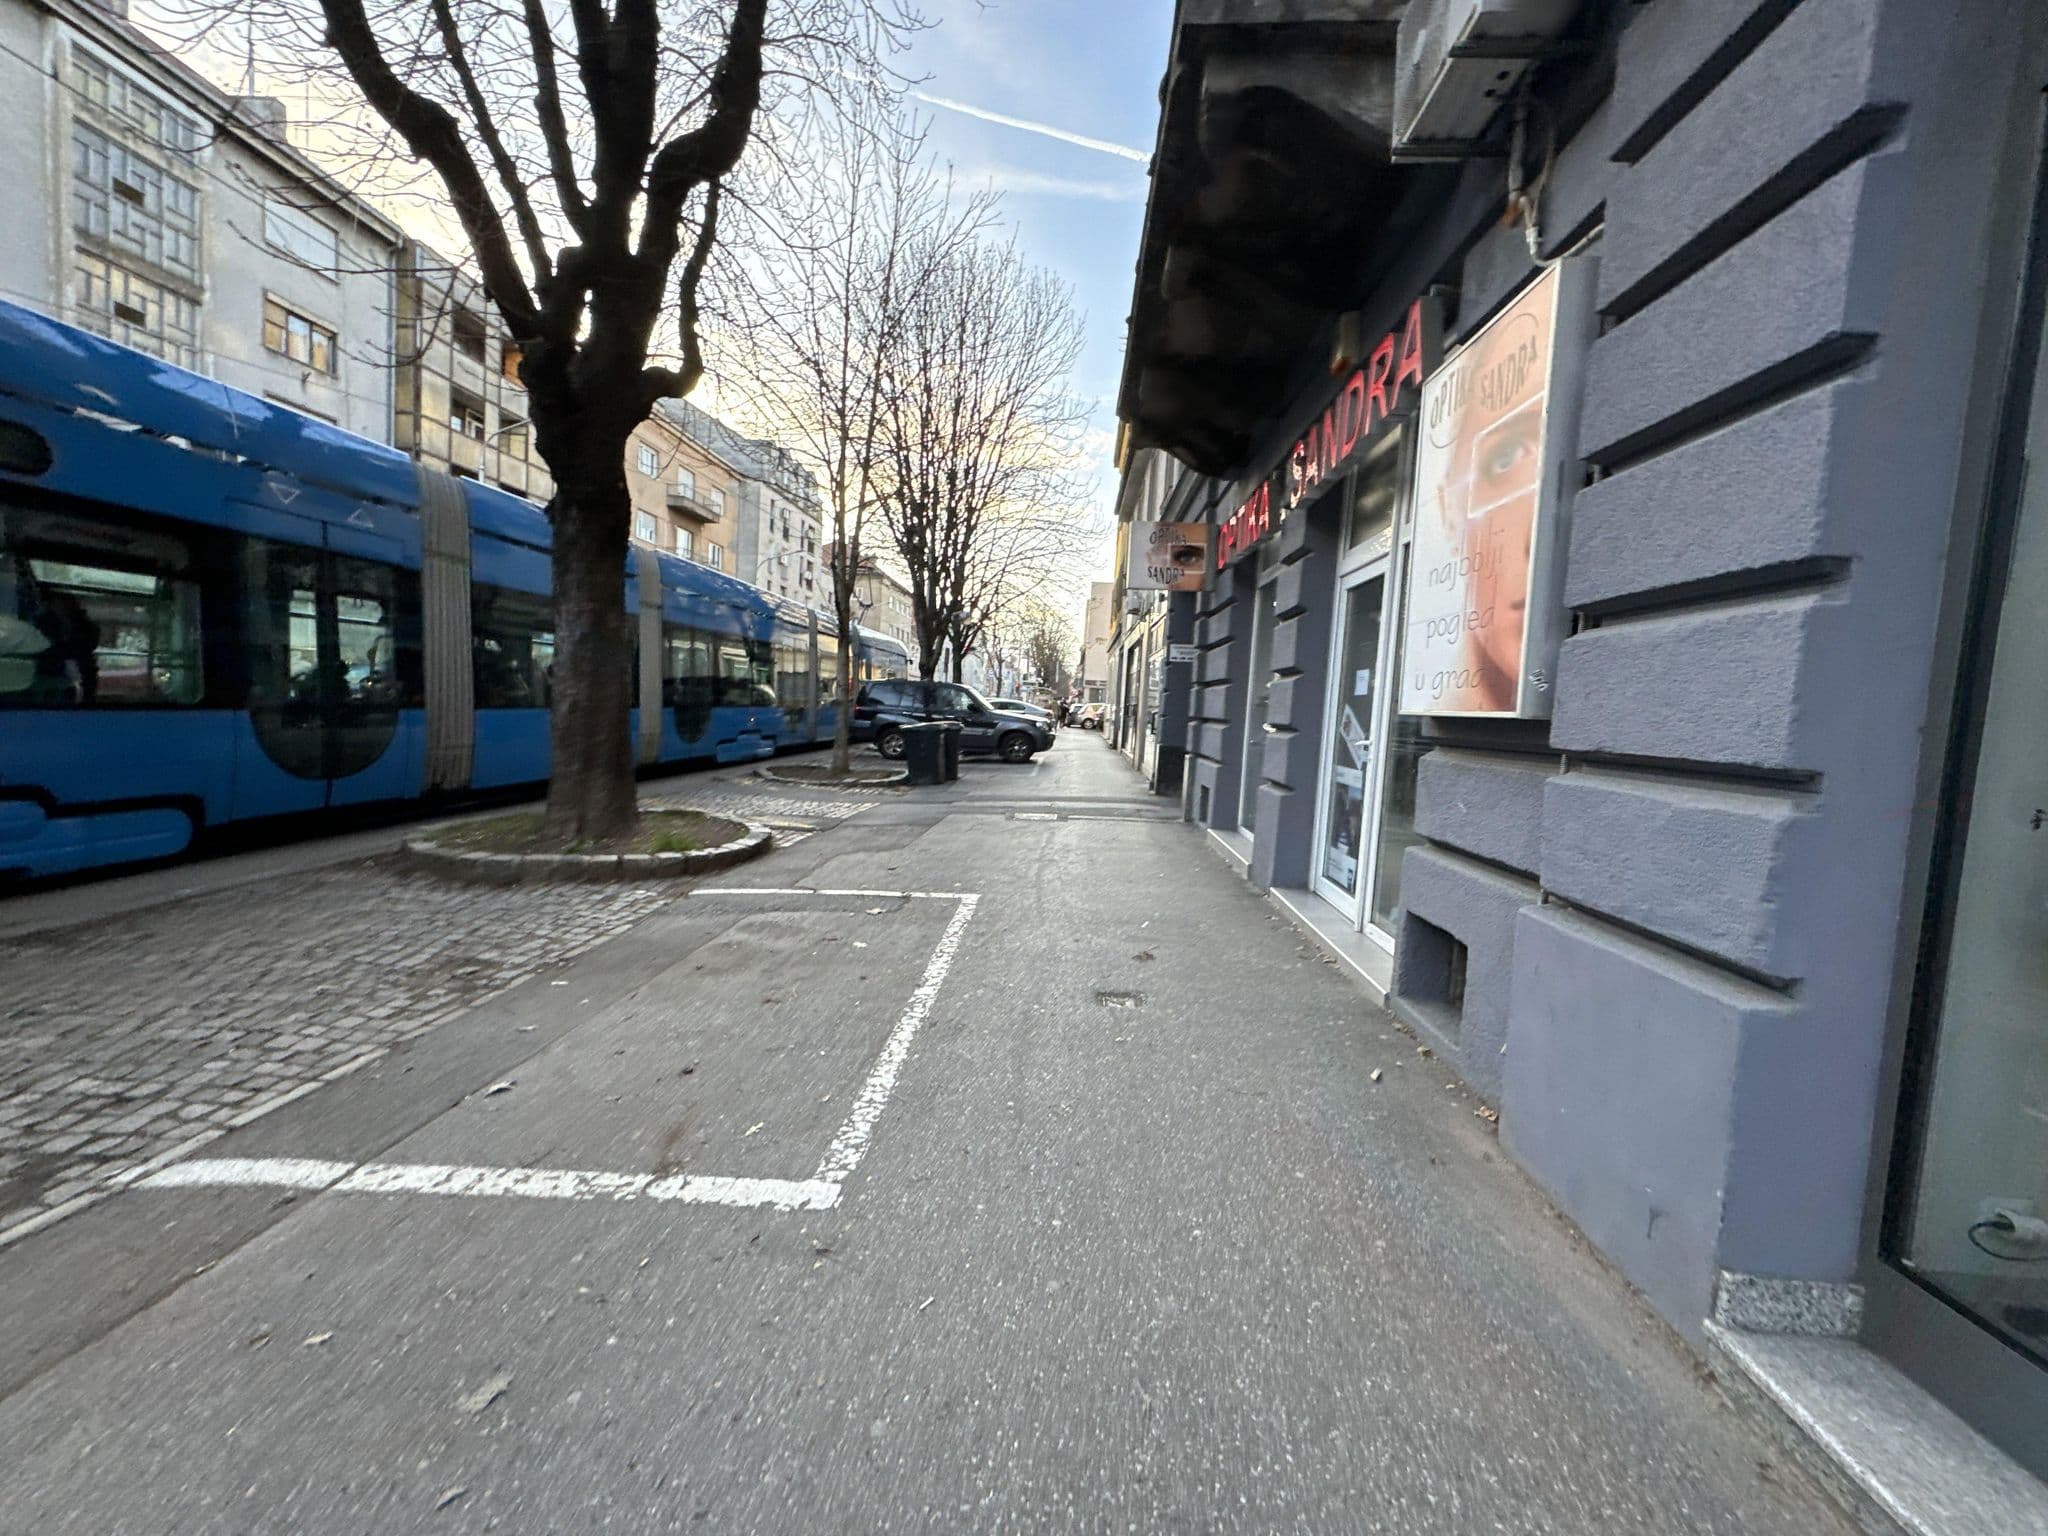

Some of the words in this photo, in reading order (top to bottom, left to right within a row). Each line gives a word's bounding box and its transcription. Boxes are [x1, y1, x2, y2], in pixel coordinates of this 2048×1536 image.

[1480, 335, 1537, 412] SANDRA
[1290, 299, 1422, 508] SANDRA
[1147, 566, 1185, 585] SANDRA
[1415, 671, 1425, 691] u
